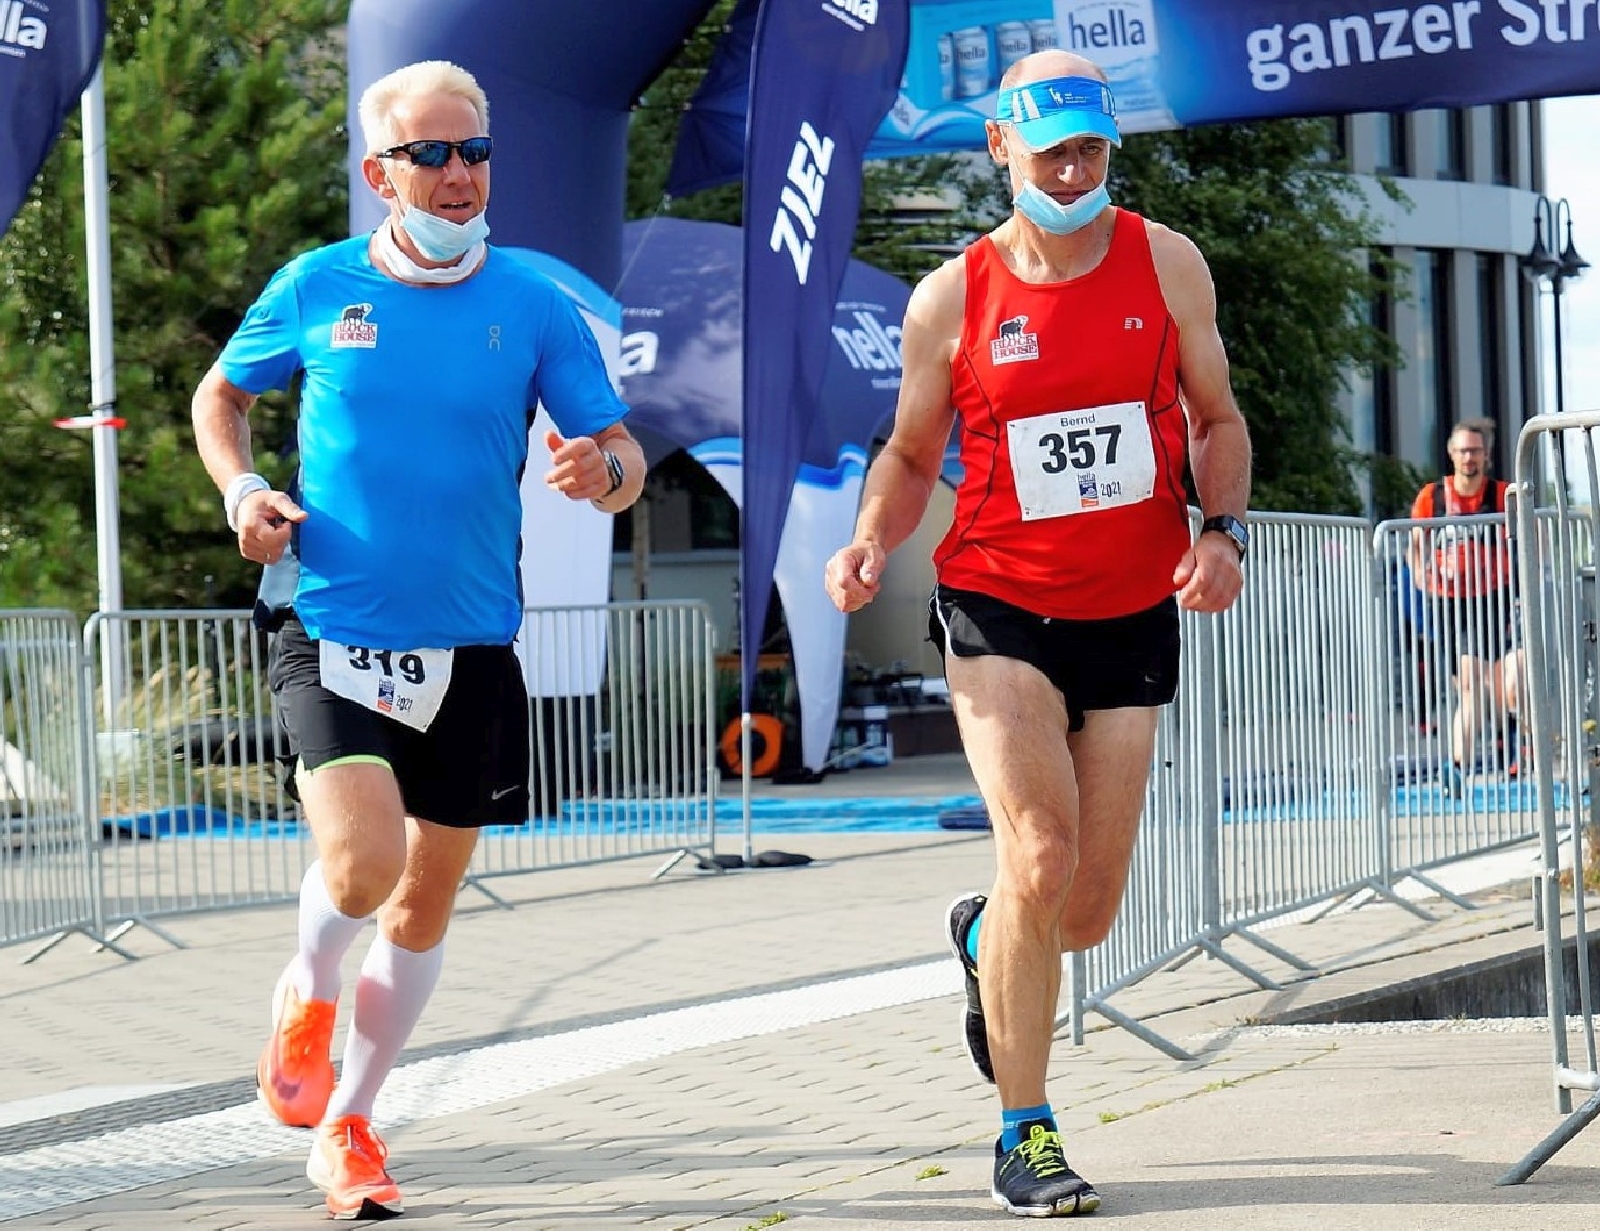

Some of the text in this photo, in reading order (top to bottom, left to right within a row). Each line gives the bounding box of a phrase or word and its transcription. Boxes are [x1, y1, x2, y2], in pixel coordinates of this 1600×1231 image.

[1068, 9, 1146, 48] hella
[1246, 0, 1600, 92] ganzer Str
[770, 121, 834, 285] ZIEL
[994, 345, 1038, 359] HOUSE
[1060, 413, 1096, 427] Bernd
[1038, 424, 1122, 473] 357
[1100, 481, 1121, 497] 2021
[347, 645, 425, 685] 319
